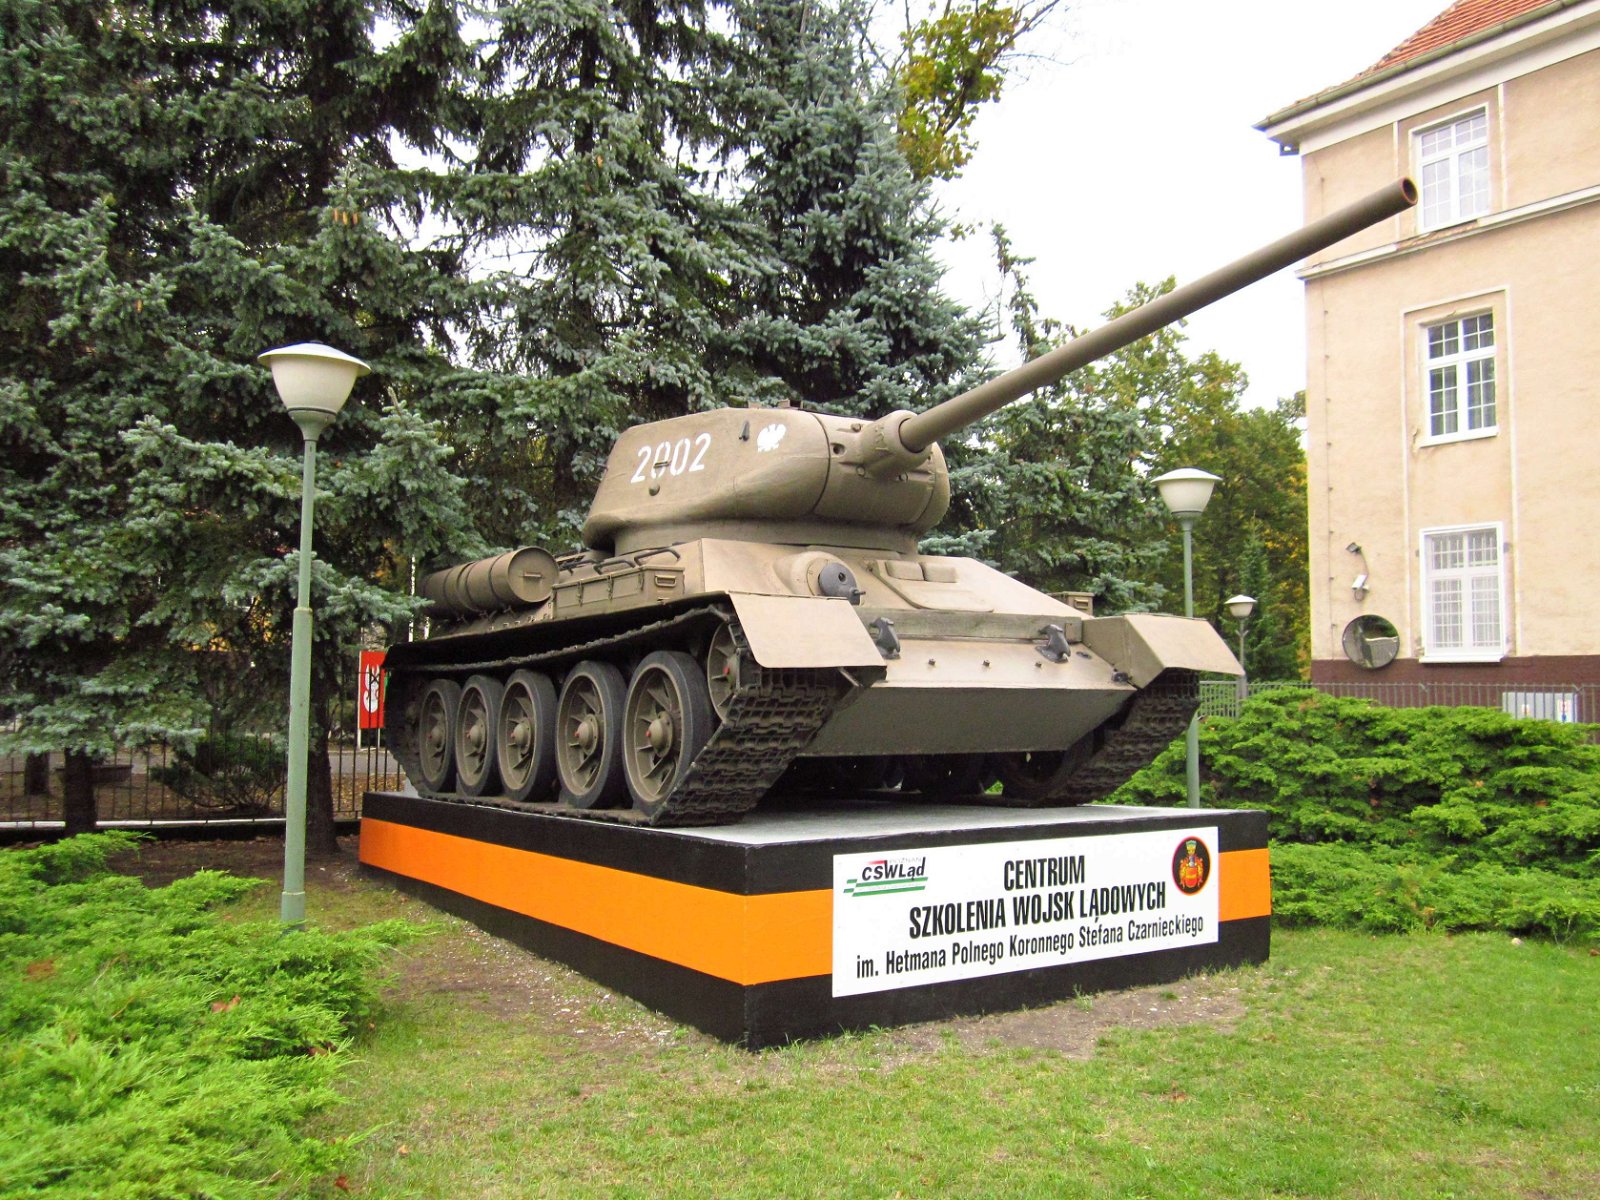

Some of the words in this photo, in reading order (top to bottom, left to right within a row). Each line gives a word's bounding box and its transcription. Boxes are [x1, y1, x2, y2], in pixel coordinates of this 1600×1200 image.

[630, 432, 712, 484] 2002
[1004, 855, 1085, 891] CENTRUM
[909, 898, 1006, 939] SZKOLENIA
[1013, 891, 1074, 926] WOJSK
[1079, 881, 1166, 923] LĄDOWYCH
[856, 955, 879, 979] im.
[886, 949, 946, 975] Hetmana
[952, 940, 1004, 965] Polnego
[1009, 932, 1074, 955] Koronnego
[1079, 924, 1123, 948] Stefana
[1128, 914, 1204, 941] Czarnieckiego
